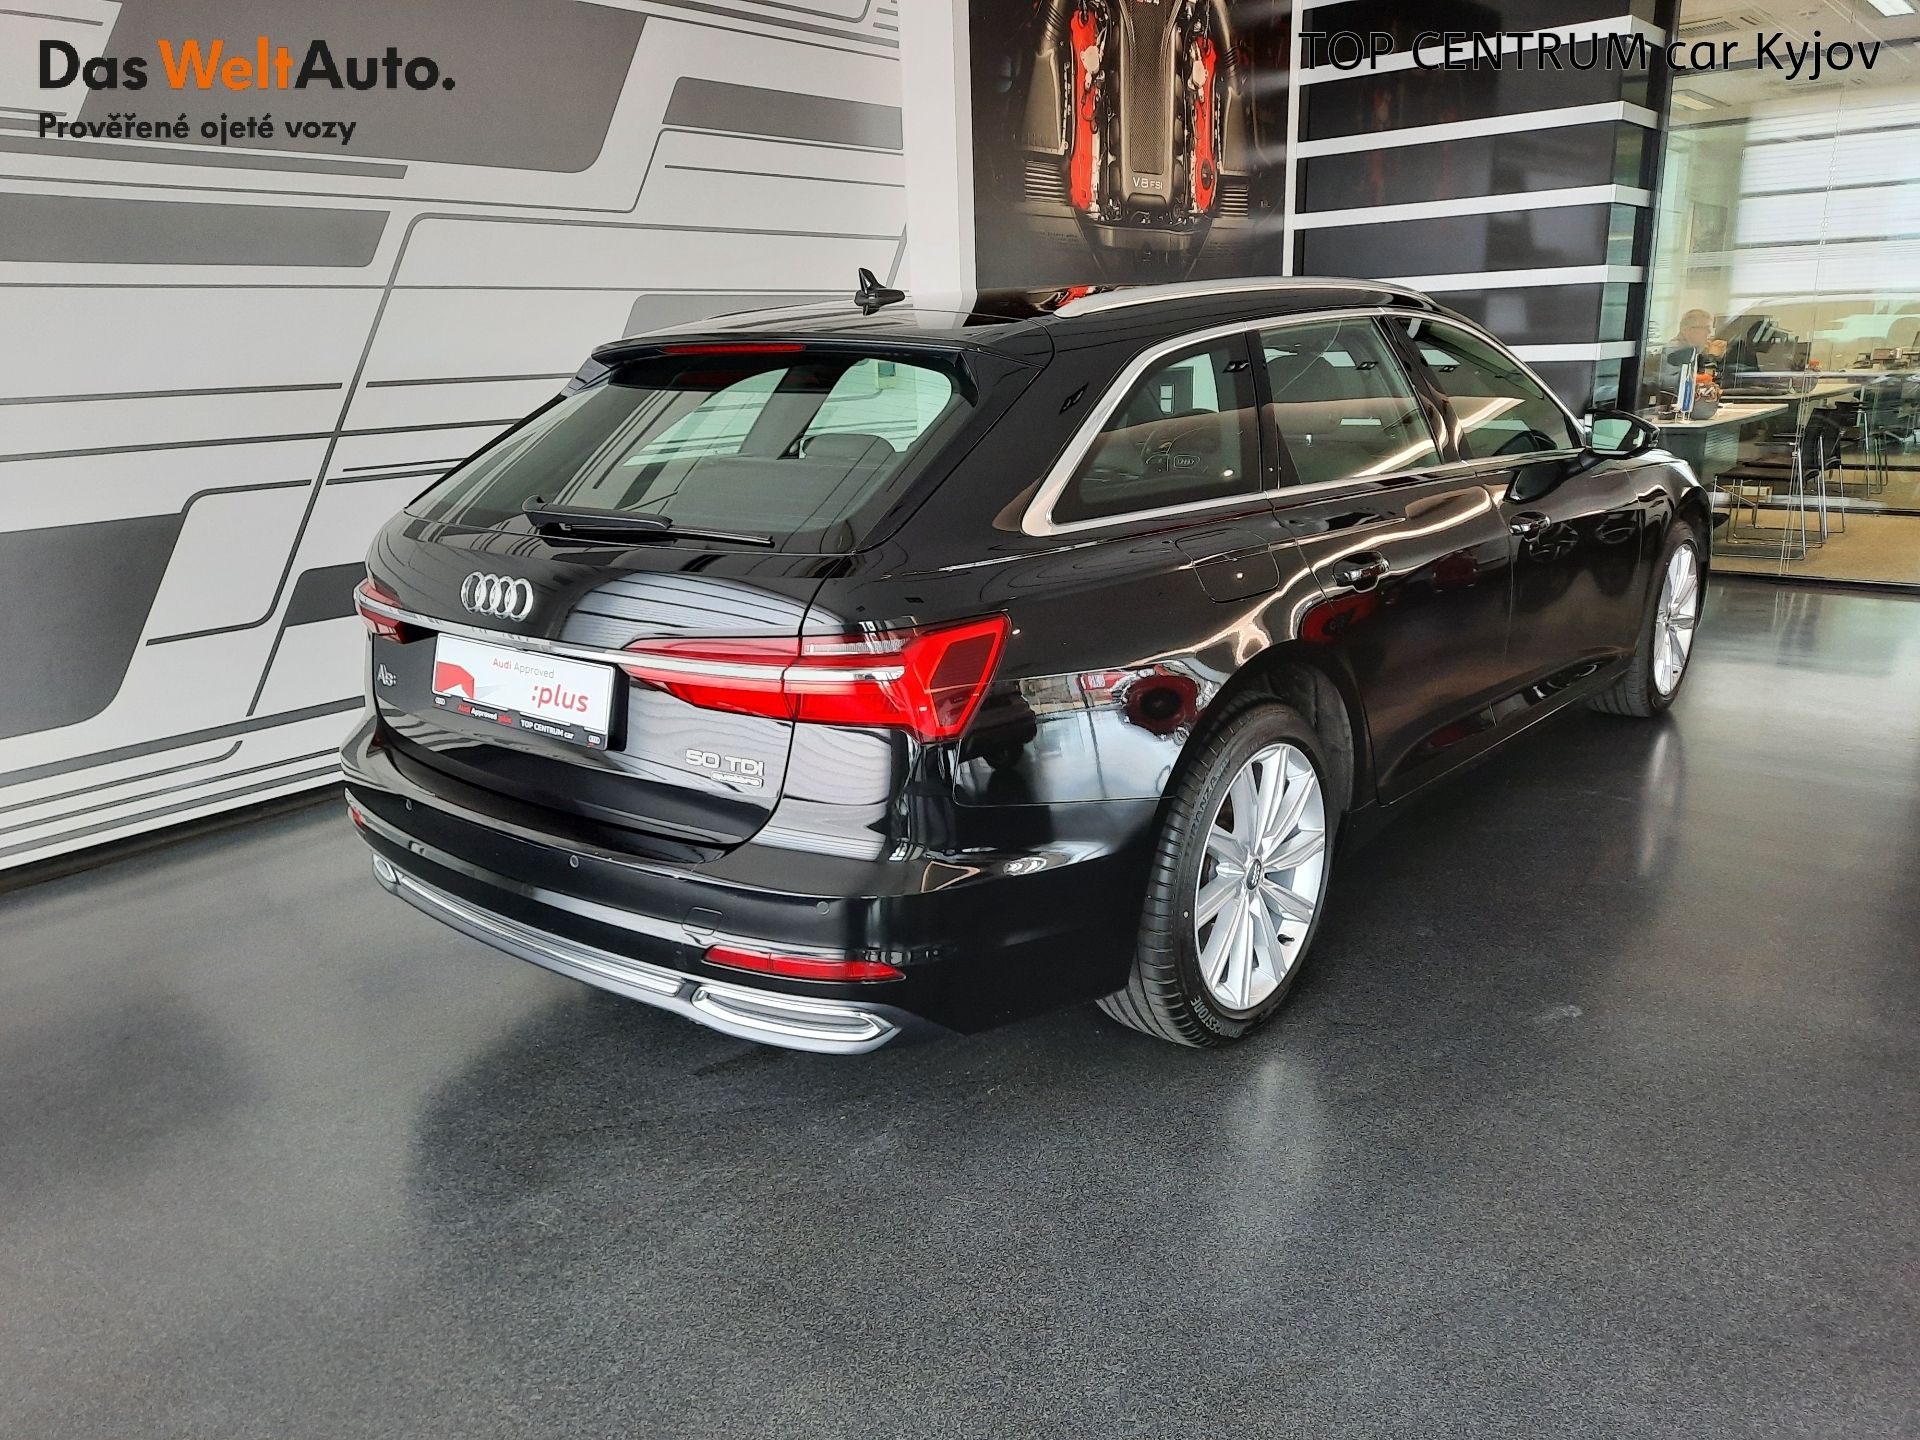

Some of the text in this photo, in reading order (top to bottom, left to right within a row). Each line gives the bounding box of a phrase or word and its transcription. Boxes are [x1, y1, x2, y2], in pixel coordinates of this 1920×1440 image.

[492, 658, 555, 679] Audi Approved
[520, 719, 534, 729] TOP
[533, 722, 564, 737] CENTRUM
[685, 749, 765, 777] 50 TDI
